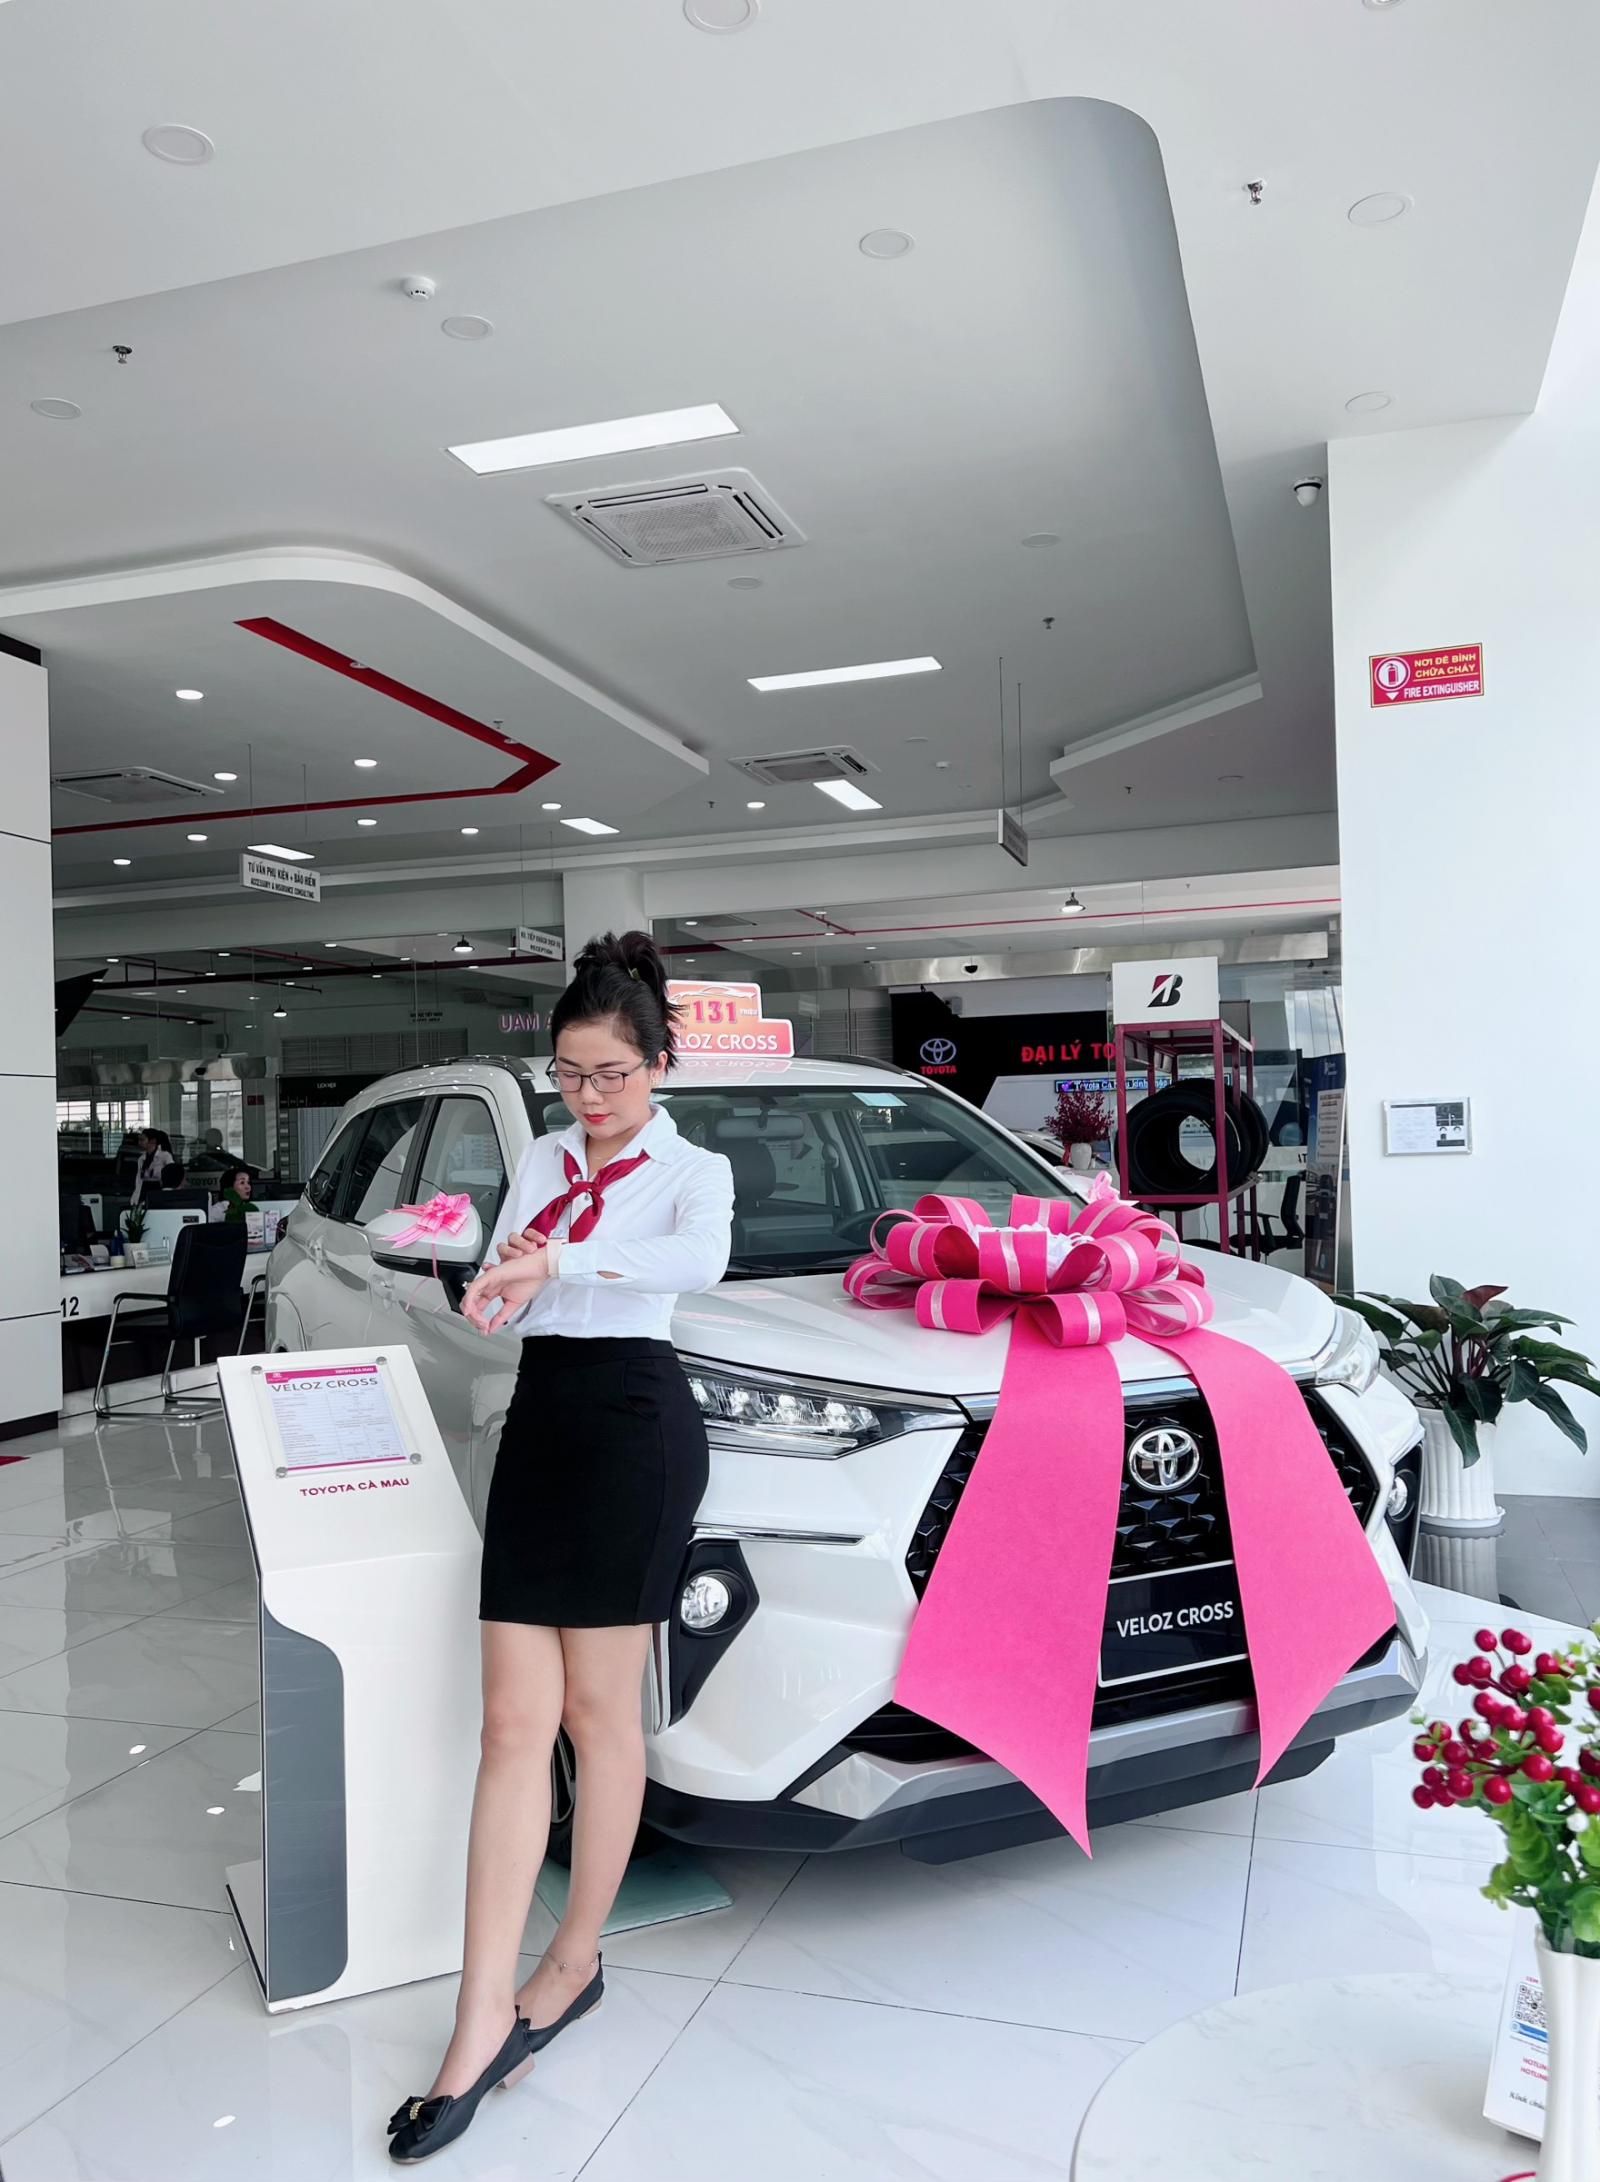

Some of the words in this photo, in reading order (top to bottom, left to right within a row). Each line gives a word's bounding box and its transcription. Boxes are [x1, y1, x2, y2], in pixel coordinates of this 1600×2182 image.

[1452, 652, 1476, 663] BÌNH
[1404, 686, 1422, 699] FIRE
[1423, 680, 1480, 697] EXTINGUISHER
[693, 1000, 738, 1024] 131
[676, 1033, 713, 1050] LOZ
[717, 1034, 778, 1051] CROSS
[1021, 1044, 1055, 1066] ĐẠI
[1061, 1039, 1082, 1061] LÝ
[920, 1065, 958, 1075] TOYOTA
[271, 1382, 322, 1392] VELOZ
[326, 1378, 378, 1389] CROSS
[299, 1484, 355, 1497] TOYOTA
[358, 1480, 378, 1490] CÀ
[380, 1478, 410, 1489] MAU
[1117, 1611, 1173, 1638] VELOZ
[1177, 1601, 1234, 1627] CROSS
